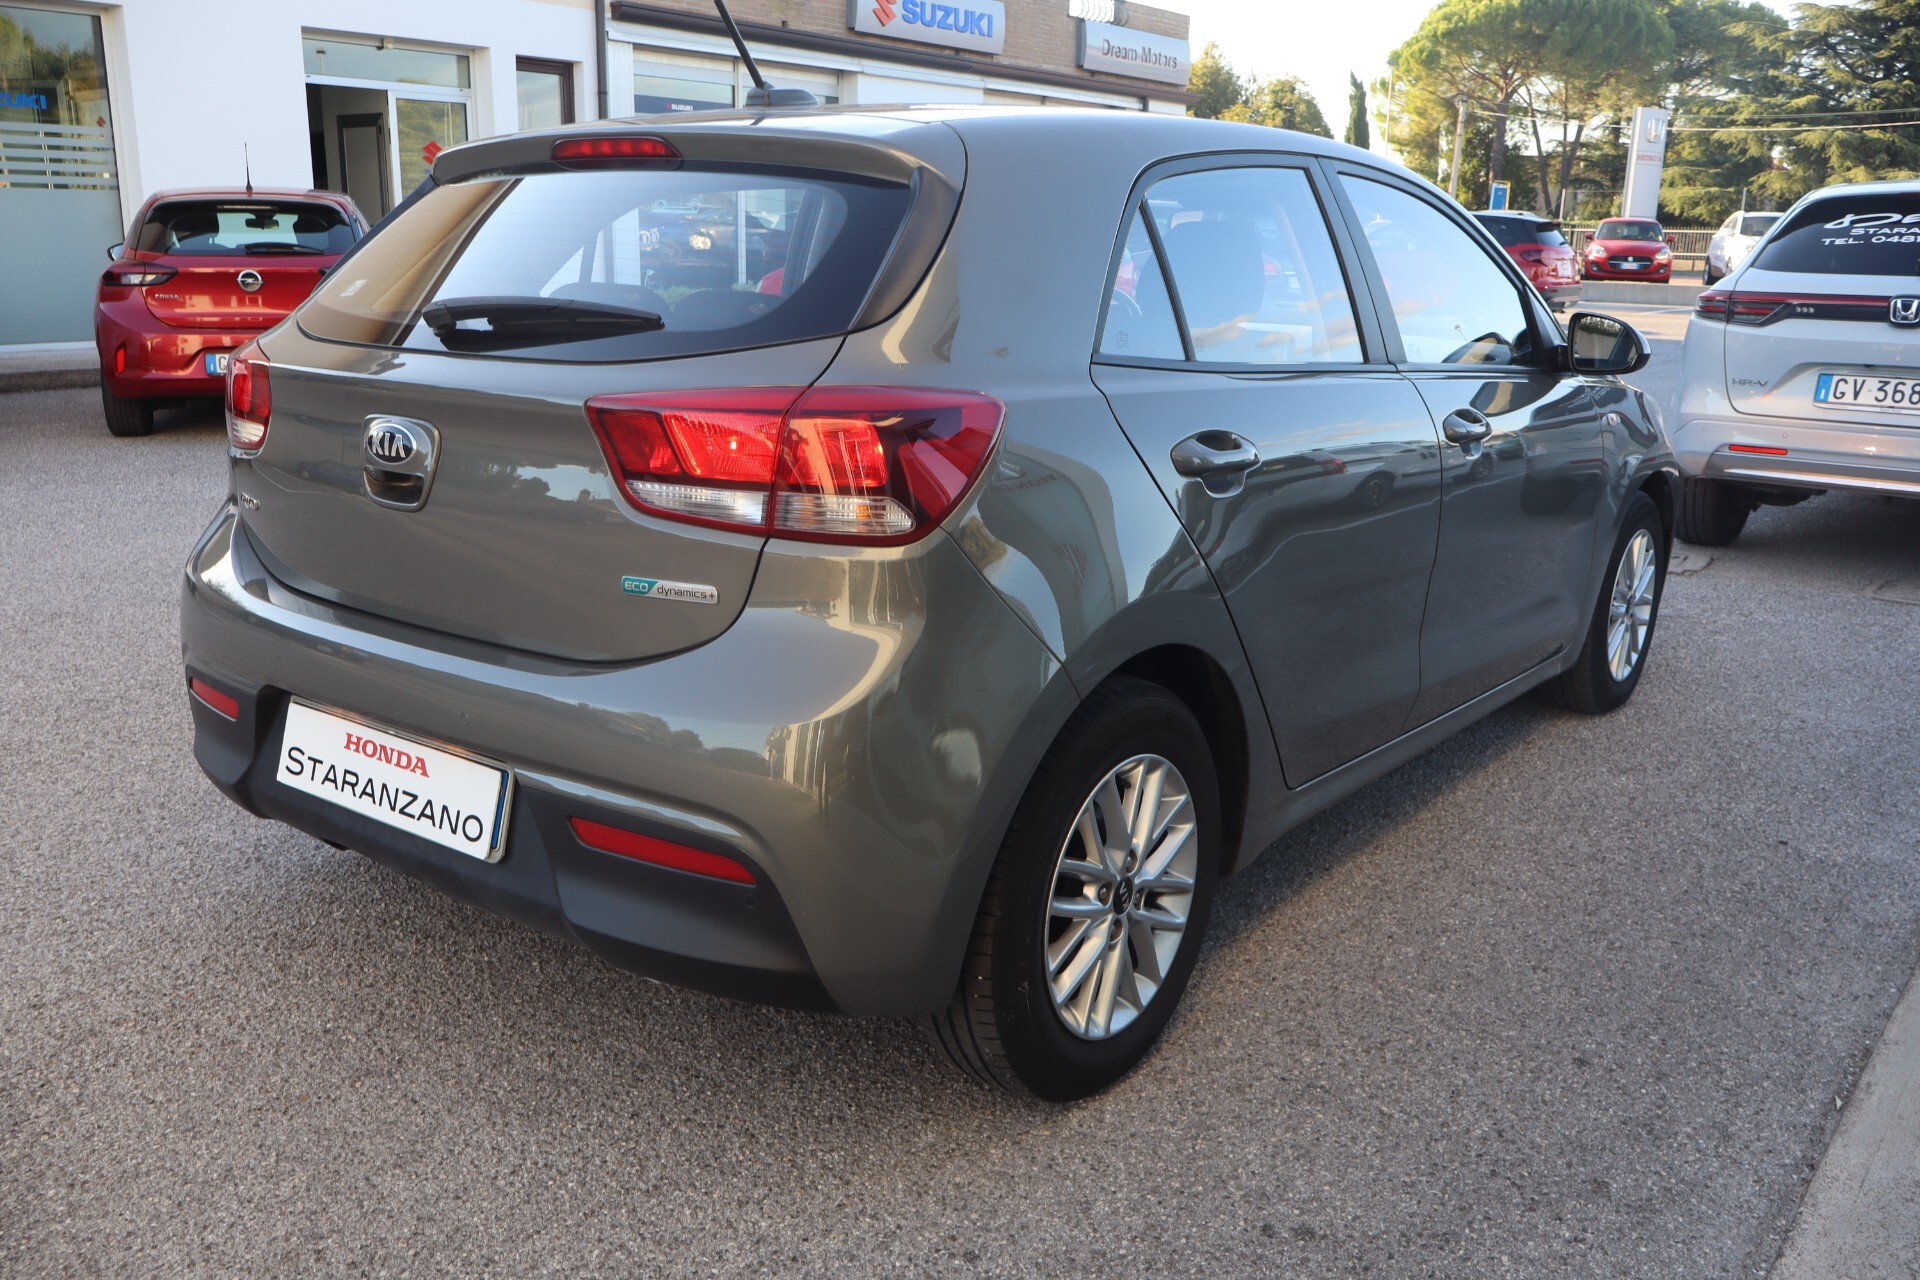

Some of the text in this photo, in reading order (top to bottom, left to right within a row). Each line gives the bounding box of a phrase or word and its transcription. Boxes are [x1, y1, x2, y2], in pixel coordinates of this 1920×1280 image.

[901, 0, 994, 38] SUZUKI
[1102, 38, 1178, 69] Dream Motors
[0, 91, 47, 110] UKI
[671, 103, 694, 112] SUZUKI
[1821, 237, 1864, 246] TEL.
[1731, 377, 1769, 387] HR-V
[1832, 378, 1866, 401] GV
[1874, 380, 1920, 405] 368
[371, 430, 407, 458] KIA
[624, 580, 649, 592] ECO
[344, 732, 430, 779] HONDA
[285, 746, 484, 843] STARANZANO
